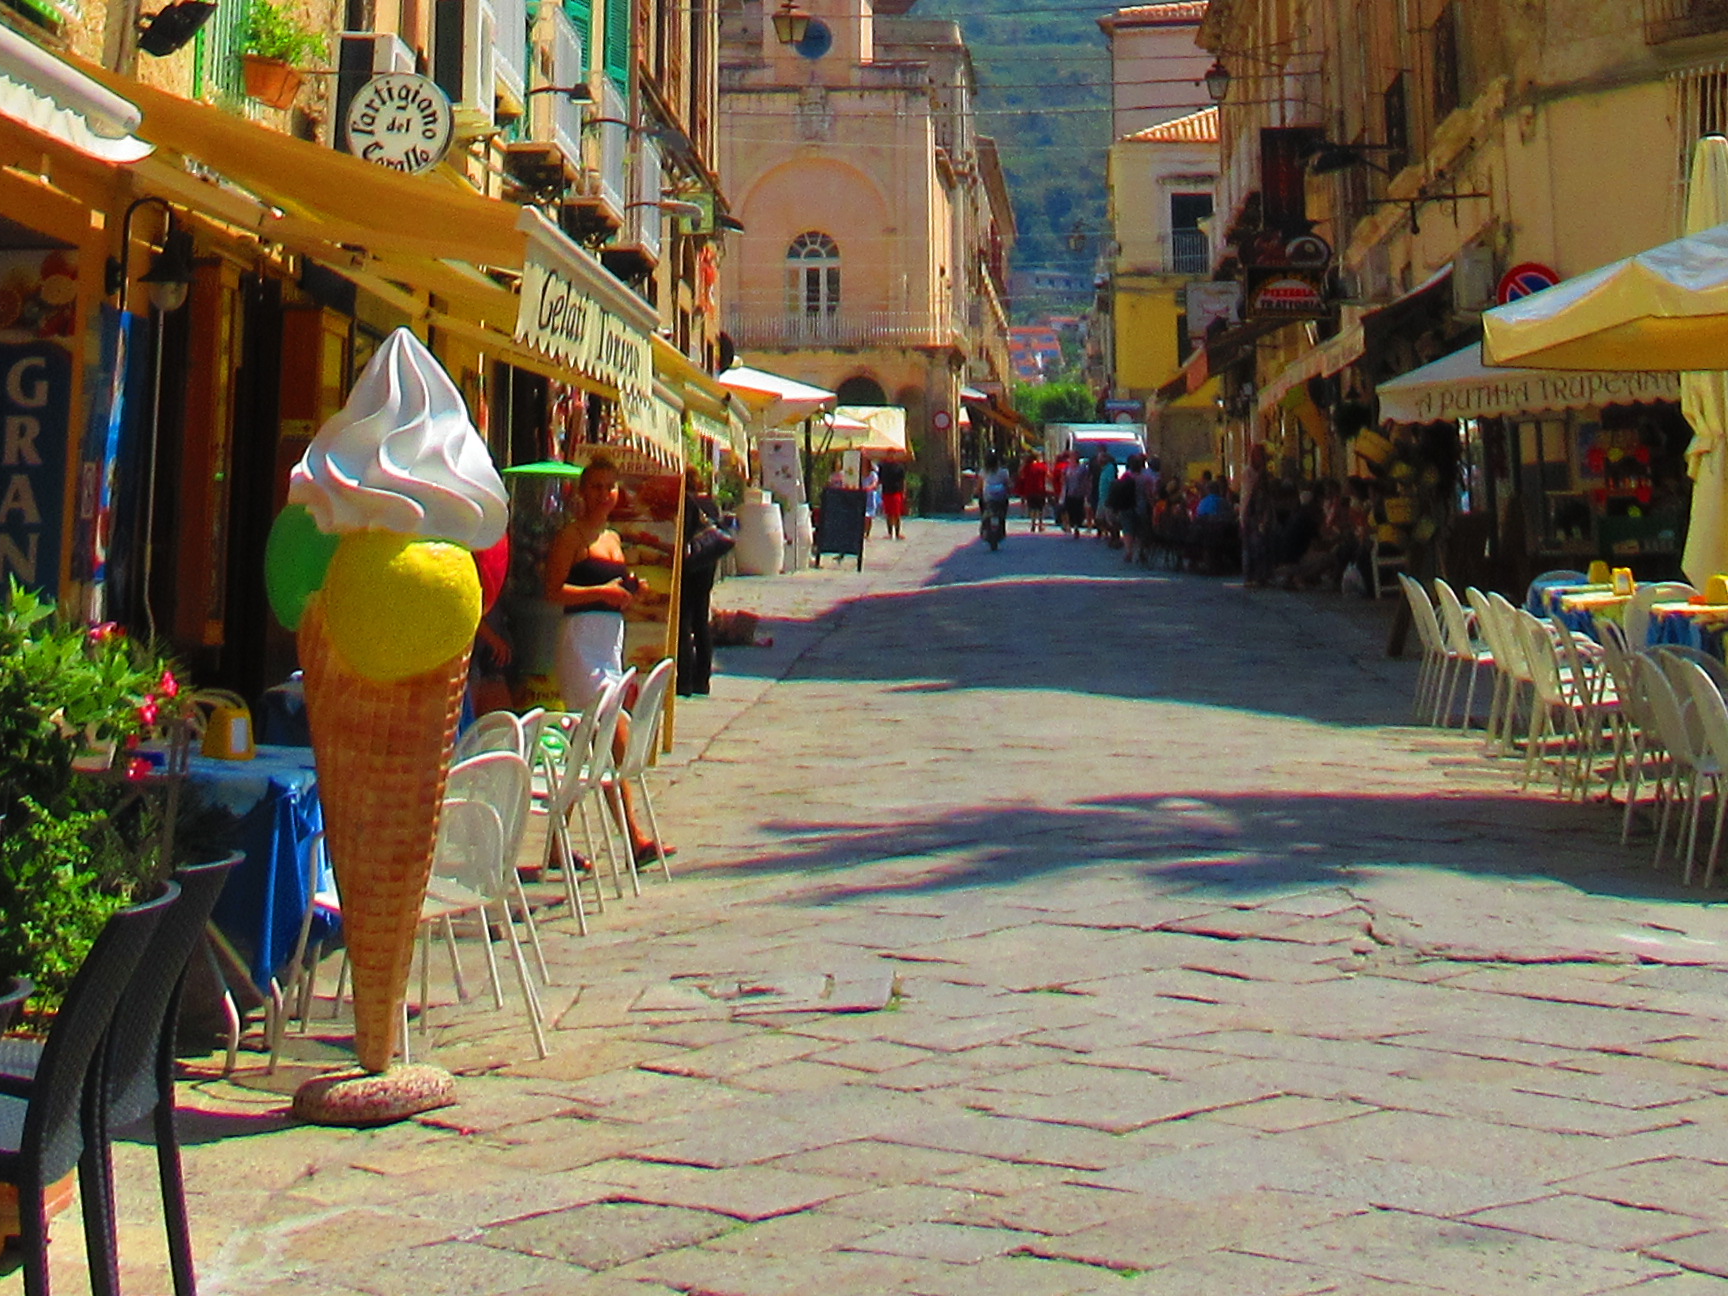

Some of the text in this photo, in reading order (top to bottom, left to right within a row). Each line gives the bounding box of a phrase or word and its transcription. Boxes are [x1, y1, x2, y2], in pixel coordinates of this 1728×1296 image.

[386, 116, 412, 134] del
[537, 268, 641, 379] Gelati Tonino
